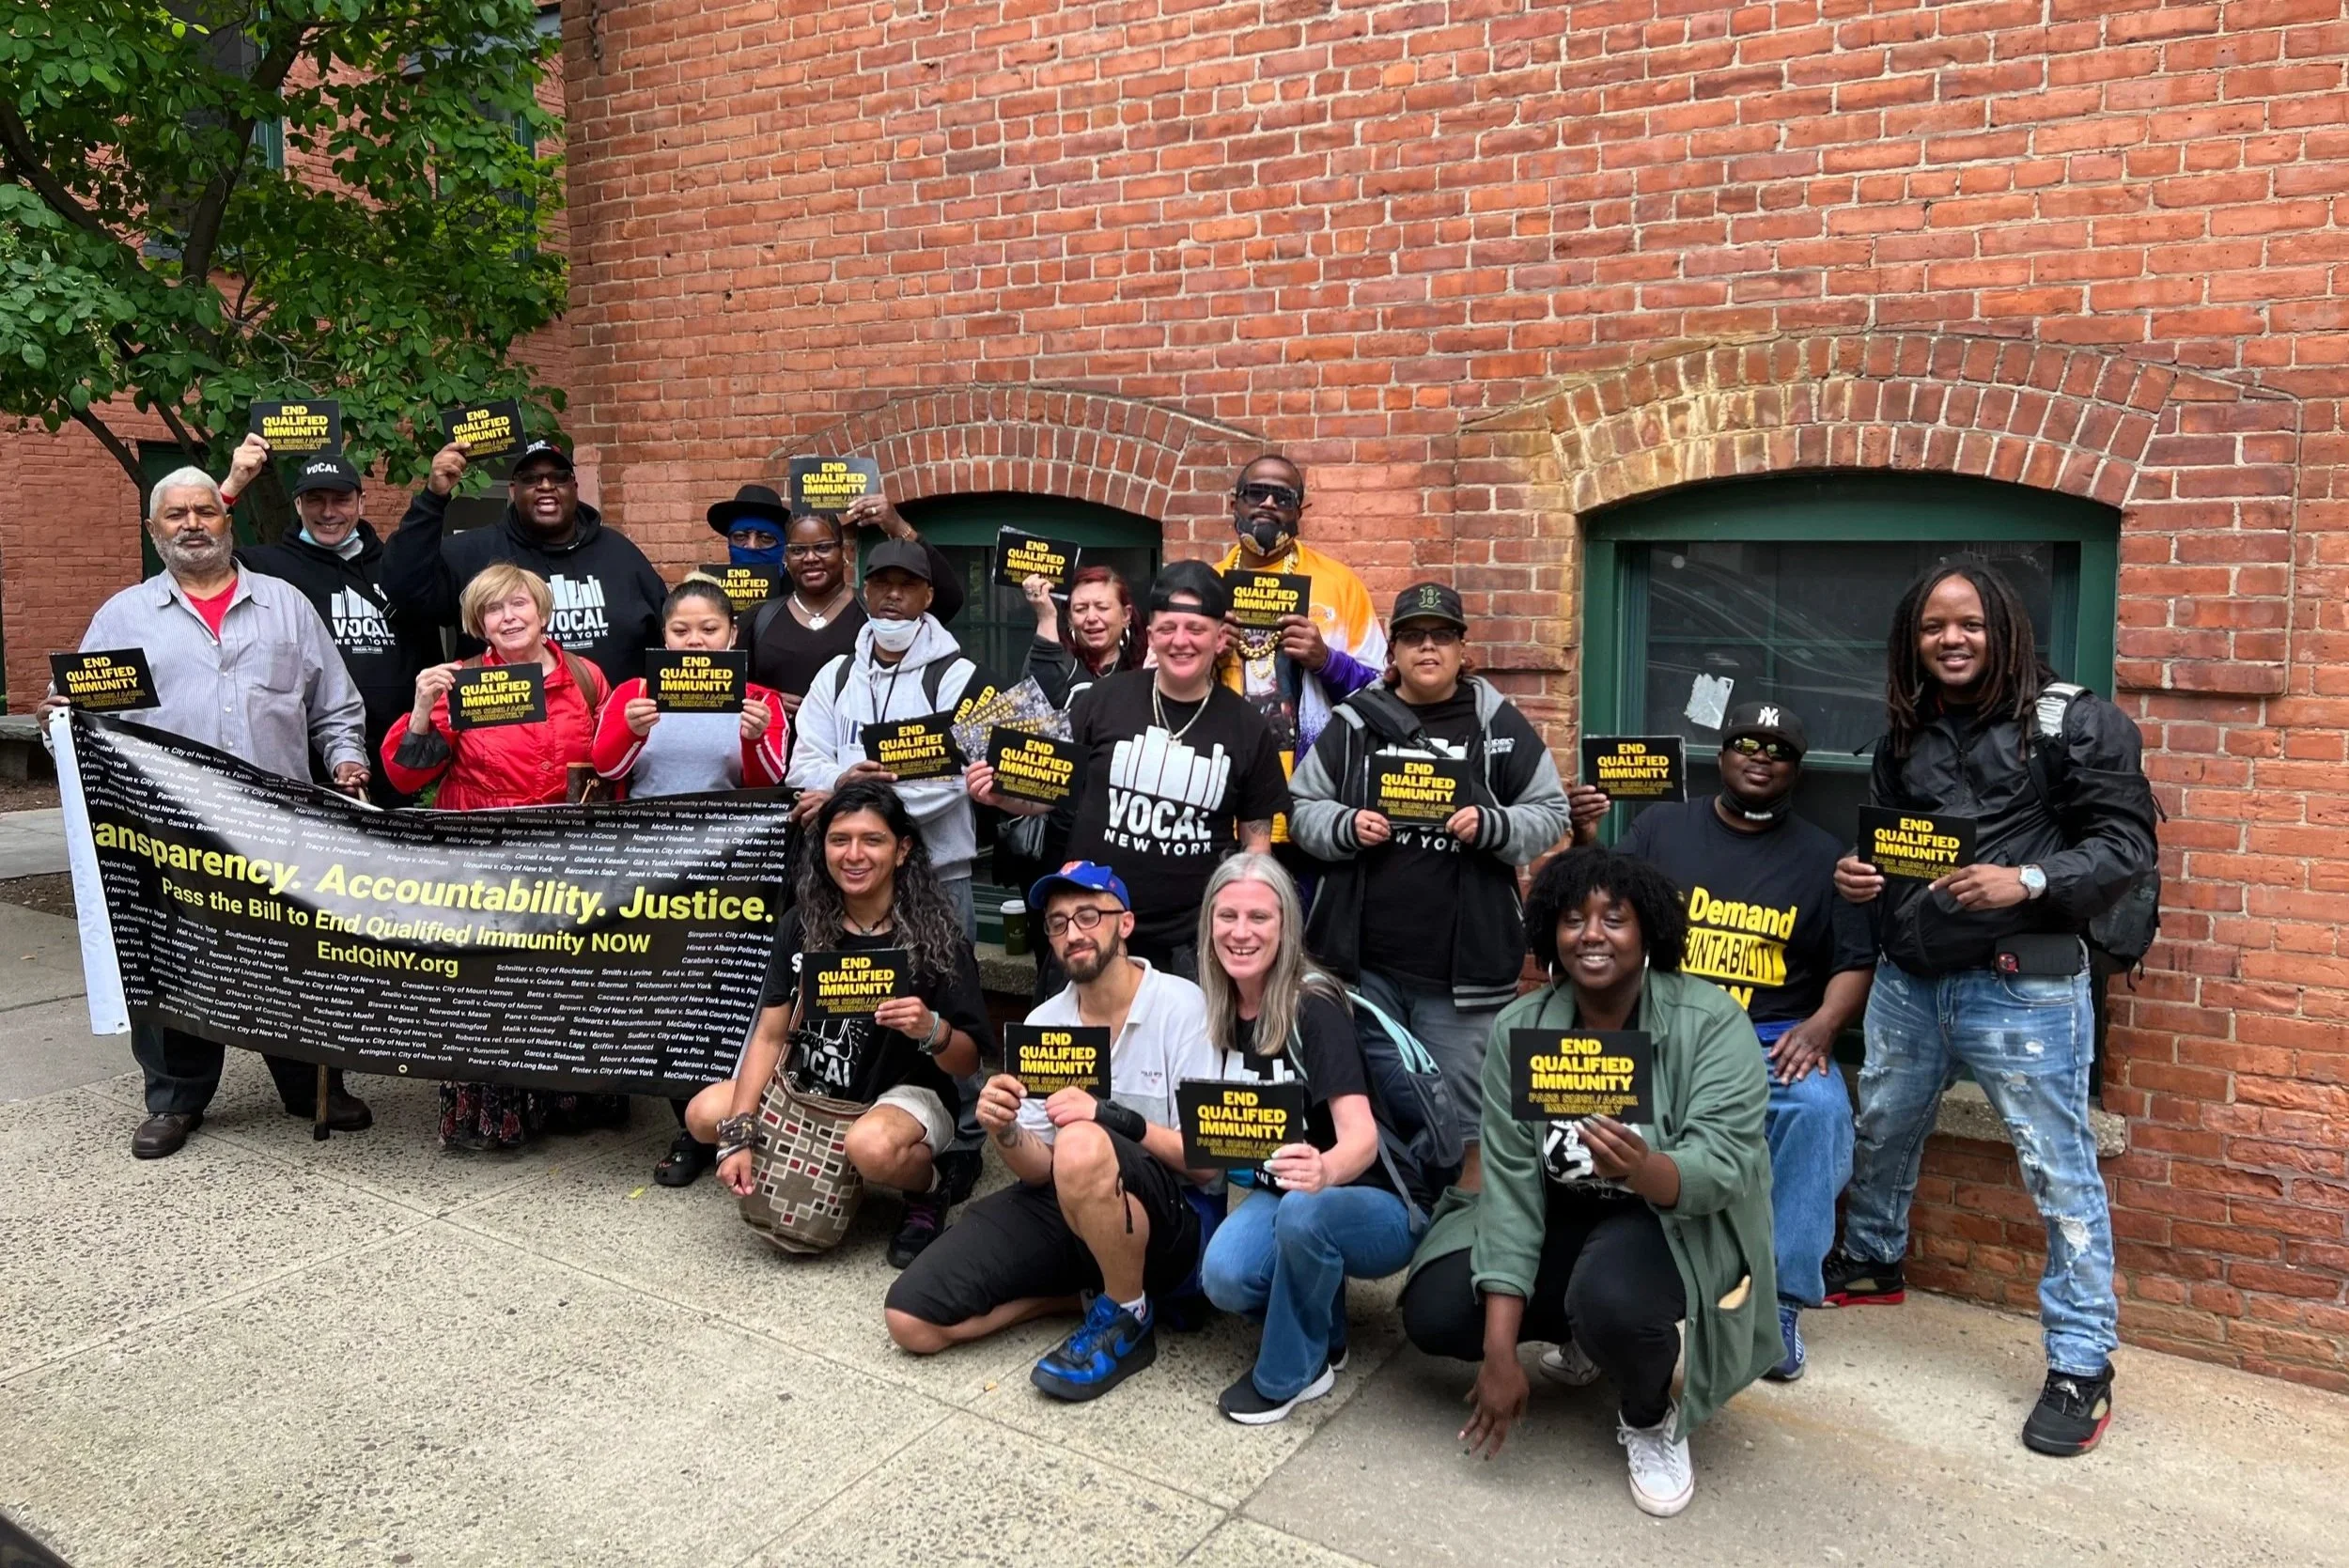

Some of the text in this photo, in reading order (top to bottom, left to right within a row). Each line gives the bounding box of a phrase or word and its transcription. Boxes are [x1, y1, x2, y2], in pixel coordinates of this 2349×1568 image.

[281, 406, 308, 415] END
[466, 409, 490, 421] END
[262, 415, 329, 427] QUALIFIED
[452, 416, 510, 435] QUALIFIED
[263, 426, 328, 437] IMMUNITY
[455, 427, 511, 443] IMMUNITY
[306, 462, 339, 474] VOCAL
[821, 462, 847, 473] END
[802, 474, 867, 484] QUALIFIED
[803, 484, 866, 494] IMMUNITY
[1025, 540, 1049, 552] END
[1008, 548, 1066, 566] QUALIFIED
[727, 569, 751, 579] END
[1007, 558, 1064, 576] IMMUNITY
[719, 579, 769, 588] UALIFIED
[1253, 577, 1280, 588] END
[724, 589, 768, 598] MUNITY
[1234, 587, 1299, 600] QUALIFIED
[1234, 598, 1297, 612] IMMUNITY
[332, 617, 395, 638] VOCAL
[577, 629, 608, 639] YORK
[83, 657, 111, 668] END
[682, 657, 711, 667] END
[66, 666, 136, 682] QUALIFIED
[480, 671, 508, 683] END
[660, 669, 733, 679] QUALIFIED
[69, 677, 138, 693] IMMUNITY
[459, 680, 531, 696] QUALIFIED
[661, 680, 732, 691] IMMUNITY
[461, 691, 531, 707] IMMUNITY
[953, 697, 973, 723] END
[897, 724, 926, 737] END
[1025, 739, 1054, 755] END
[1618, 743, 1646, 754] END
[1001, 748, 1074, 771] QUALIFIED
[1597, 755, 1669, 768] QUALIFIED
[999, 760, 1070, 785] IMMUNITY
[1404, 762, 1434, 775] END
[1599, 768, 1669, 779] IMMUNITY
[1380, 773, 1456, 789] QUALIFIED
[1381, 785, 1455, 802] IMMUNITY
[1109, 788, 1211, 840] VOCAL
[1900, 817, 1933, 832] END
[1104, 829, 1211, 856] NEW YORK
[1421, 835, 1460, 852] YOR
[1875, 829, 1960, 849] QUALIFIED
[1875, 842, 1958, 863] IMMUNITY
[94, 822, 773, 924] ansparency. Accountability. Justice.
[162, 877, 651, 956] Pass the Bill to End Qualified Immunity NOW
[1688, 886, 1797, 940] Demand
[226, 929, 261, 942] Southerland
[269, 939, 288, 947] Garcia
[317, 940, 459, 978] EndQiNY.org
[841, 956, 871, 970] END
[1683, 930, 1774, 981] UNTABILITY
[559, 967, 594, 975] Rochester
[817, 969, 894, 984] QUALIFIED
[401, 982, 434, 991] Crenshaw
[818, 982, 894, 997] IMMUNITY
[388, 1015, 413, 1024] Burgess
[450, 1022, 488, 1031] Wallingford
[1041, 1032, 1072, 1046] END
[1561, 1038, 1602, 1055] END
[1019, 1047, 1097, 1061] QUALIFIED
[521, 1062, 537, 1070] Long
[801, 1043, 850, 1088] CAL
[1020, 1060, 1096, 1075] IMMUNITY
[1530, 1056, 1634, 1074] QUALIFIED
[1532, 1074, 1633, 1092] IMMUNITY
[1223, 1091, 1259, 1107] END
[1197, 1105, 1287, 1124] QUALIFIED
[1199, 1121, 1286, 1141] IMMUNITY
